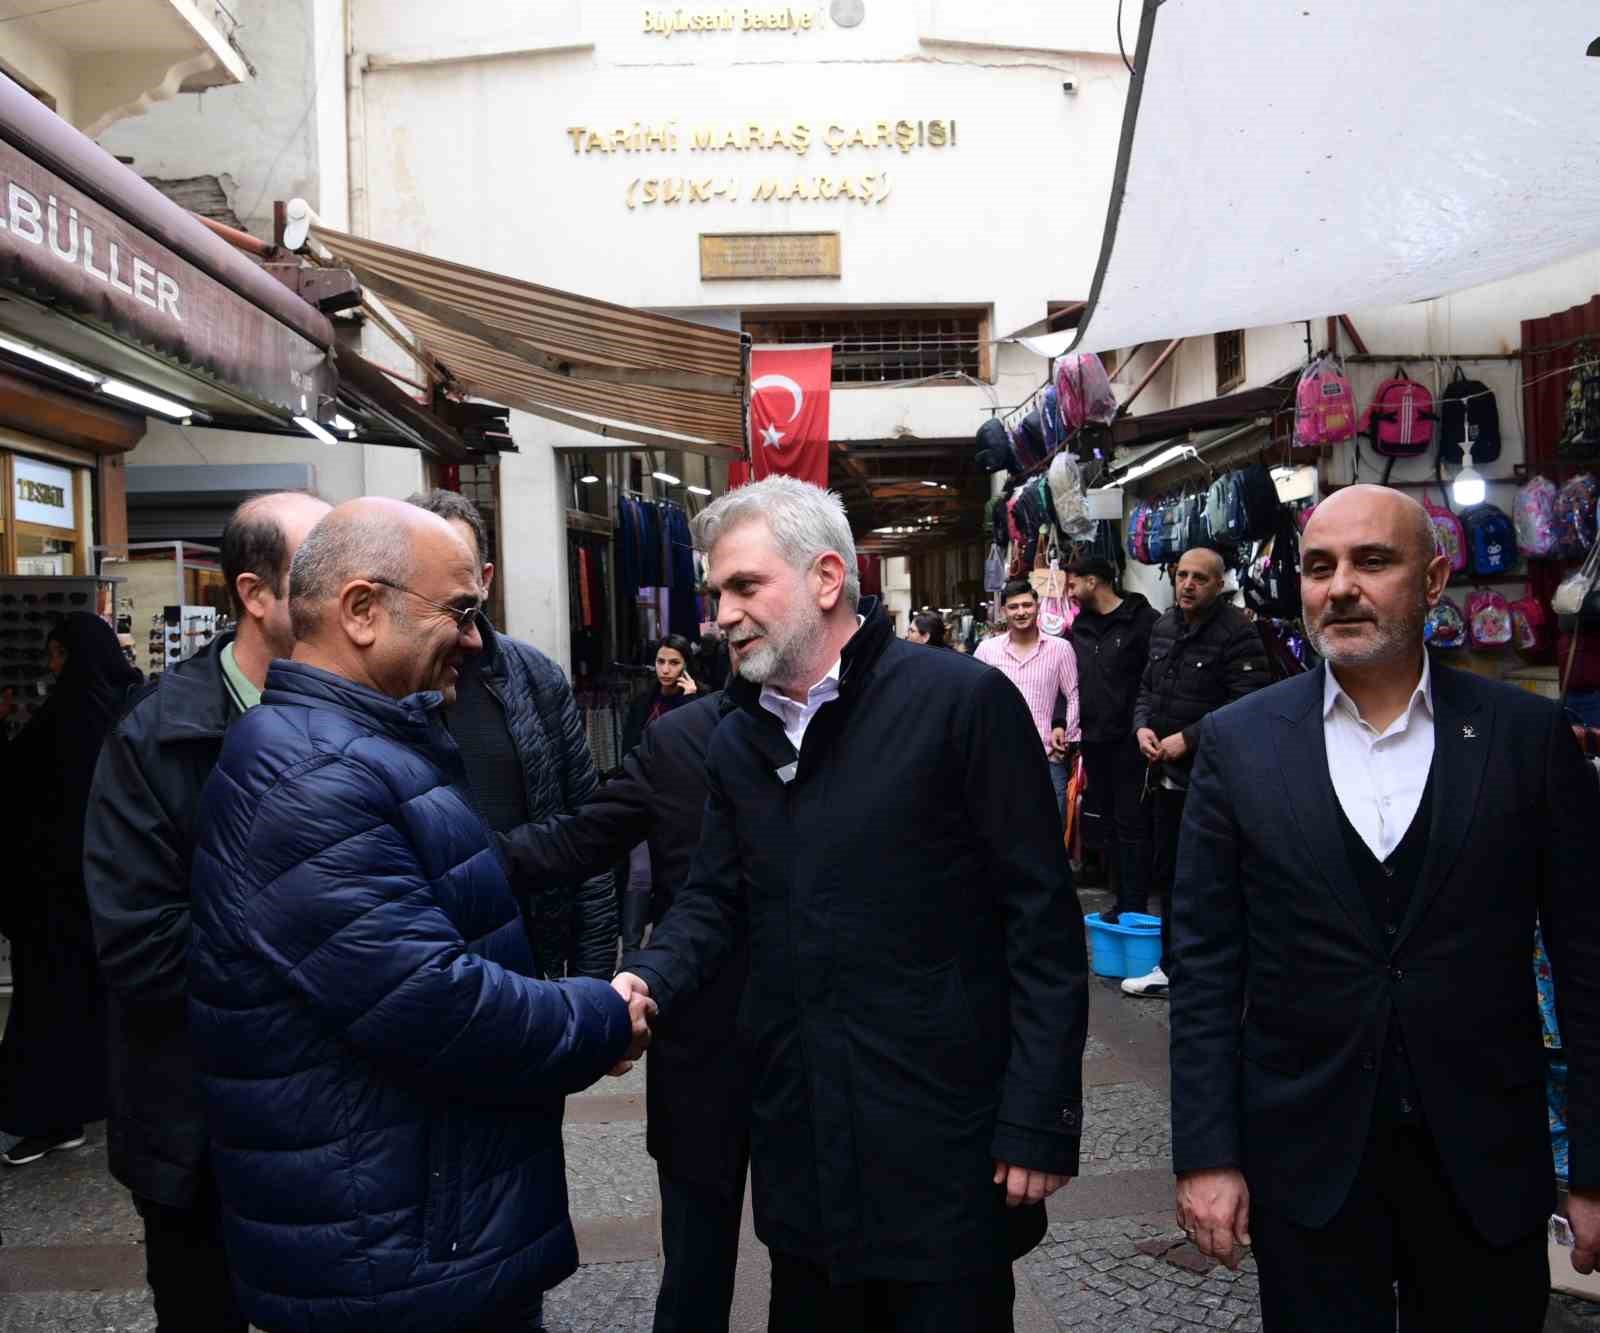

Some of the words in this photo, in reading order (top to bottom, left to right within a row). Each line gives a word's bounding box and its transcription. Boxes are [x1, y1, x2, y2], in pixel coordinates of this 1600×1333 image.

[567, 122, 678, 154] TARİHİ
[690, 123, 811, 157] MARAŞ
[823, 119, 957, 156] ÇARŞISI
[750, 171, 893, 207] MARAŞ)
[0, 181, 182, 321] BÜLLER
